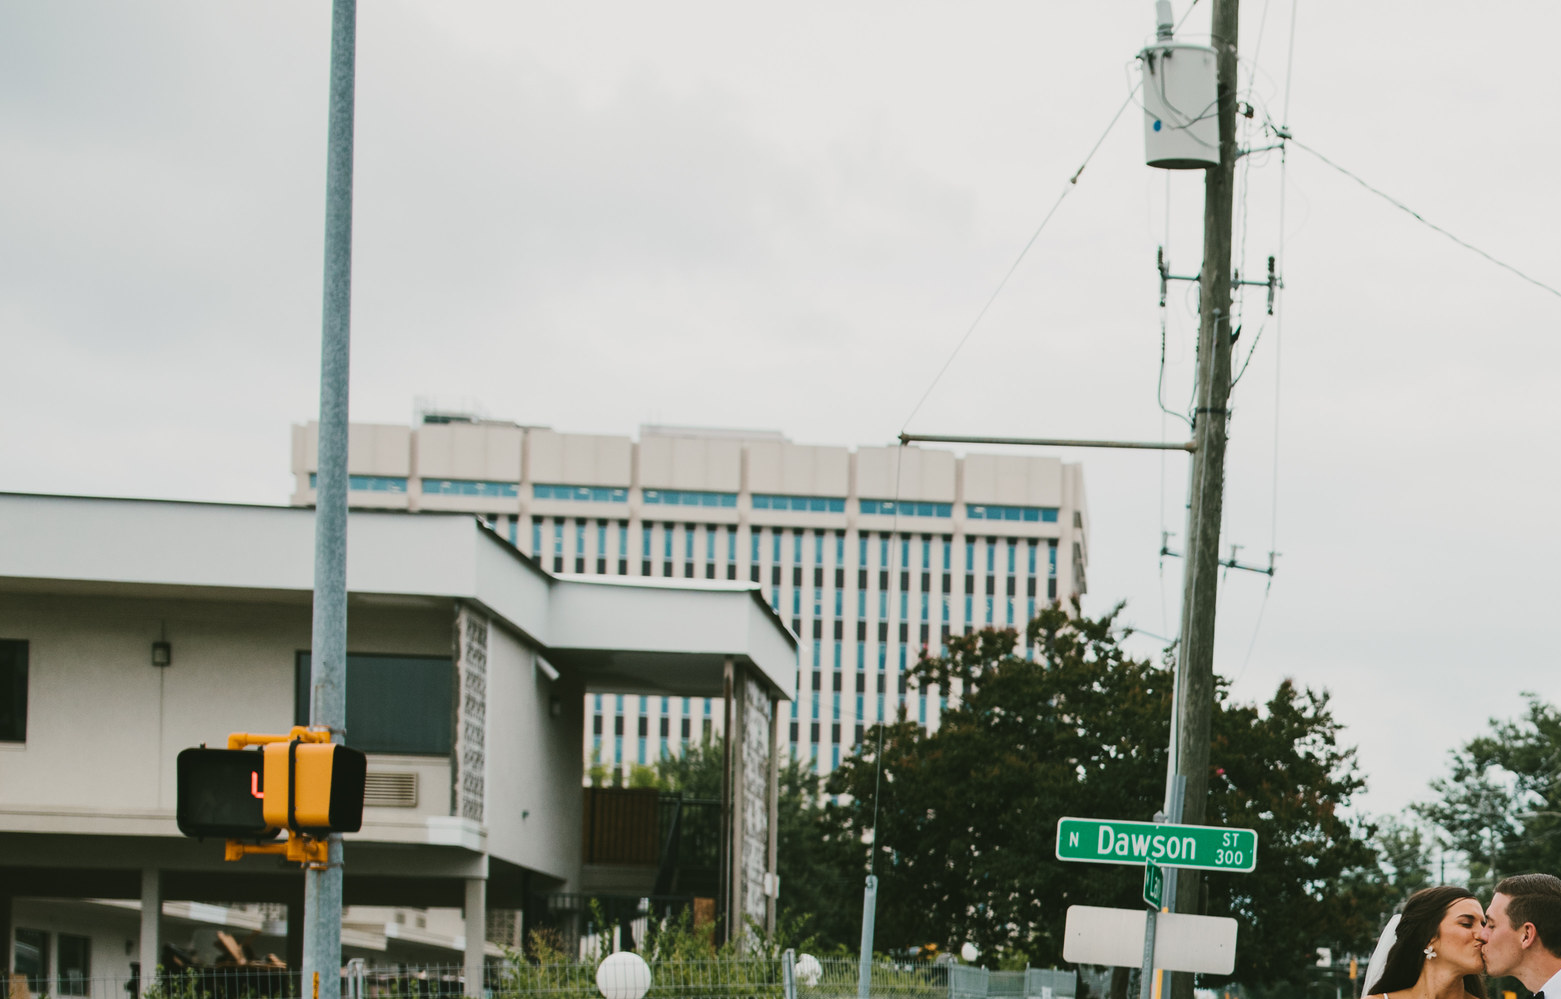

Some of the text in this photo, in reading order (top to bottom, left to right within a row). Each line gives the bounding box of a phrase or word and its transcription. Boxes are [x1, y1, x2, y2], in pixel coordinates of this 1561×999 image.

[1069, 825, 1240, 860] N Dawson ST
[1214, 849, 1243, 865] 300
